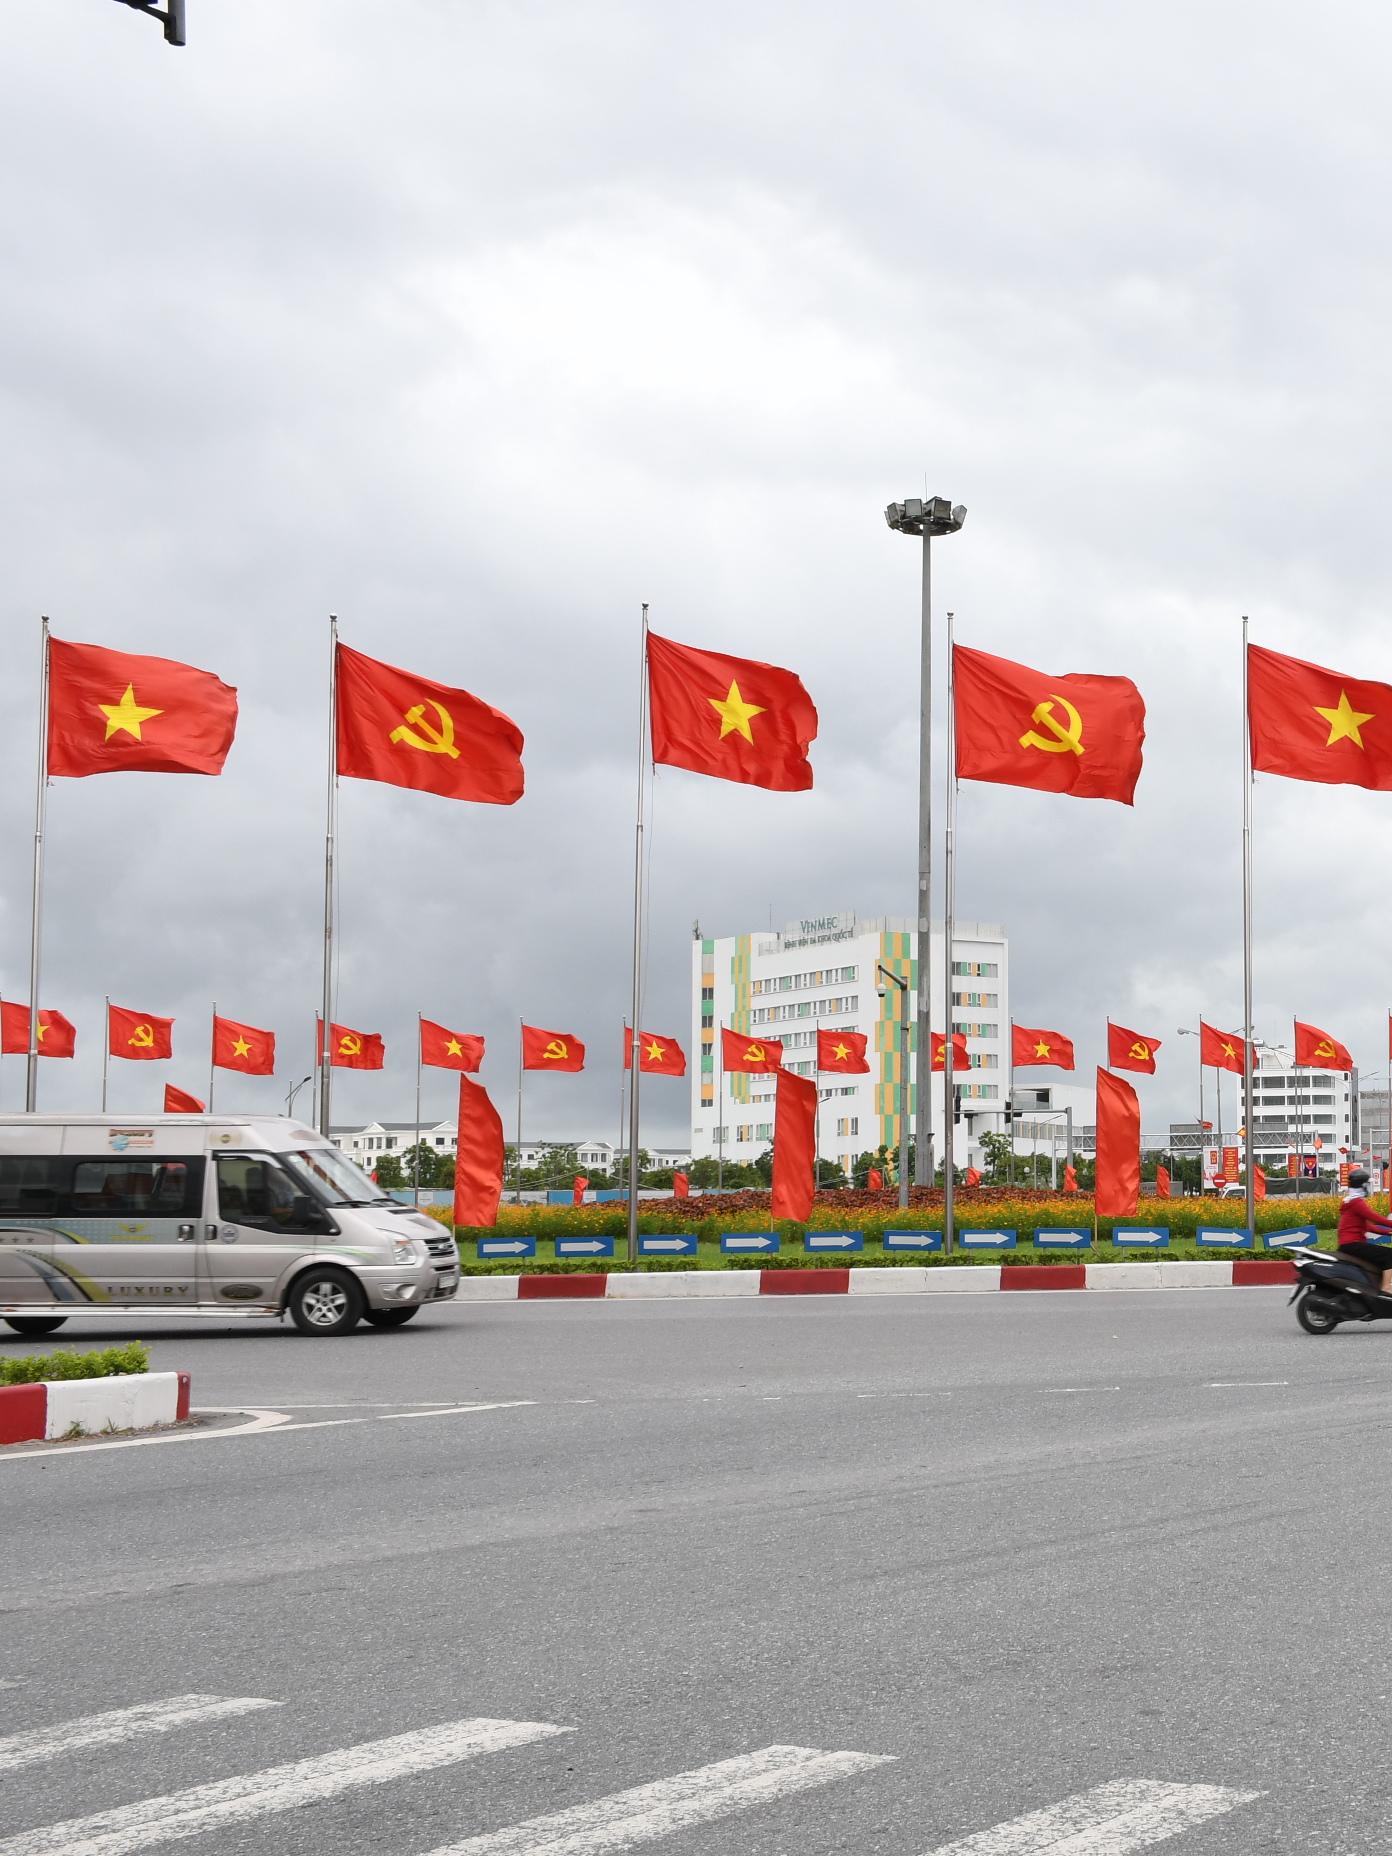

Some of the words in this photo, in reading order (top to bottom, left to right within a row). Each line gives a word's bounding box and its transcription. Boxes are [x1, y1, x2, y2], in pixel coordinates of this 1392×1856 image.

[800, 917, 837, 933] VINMEC
[817, 934, 831, 943] KHOA
[107, 1286, 188, 1297] LUXURY
